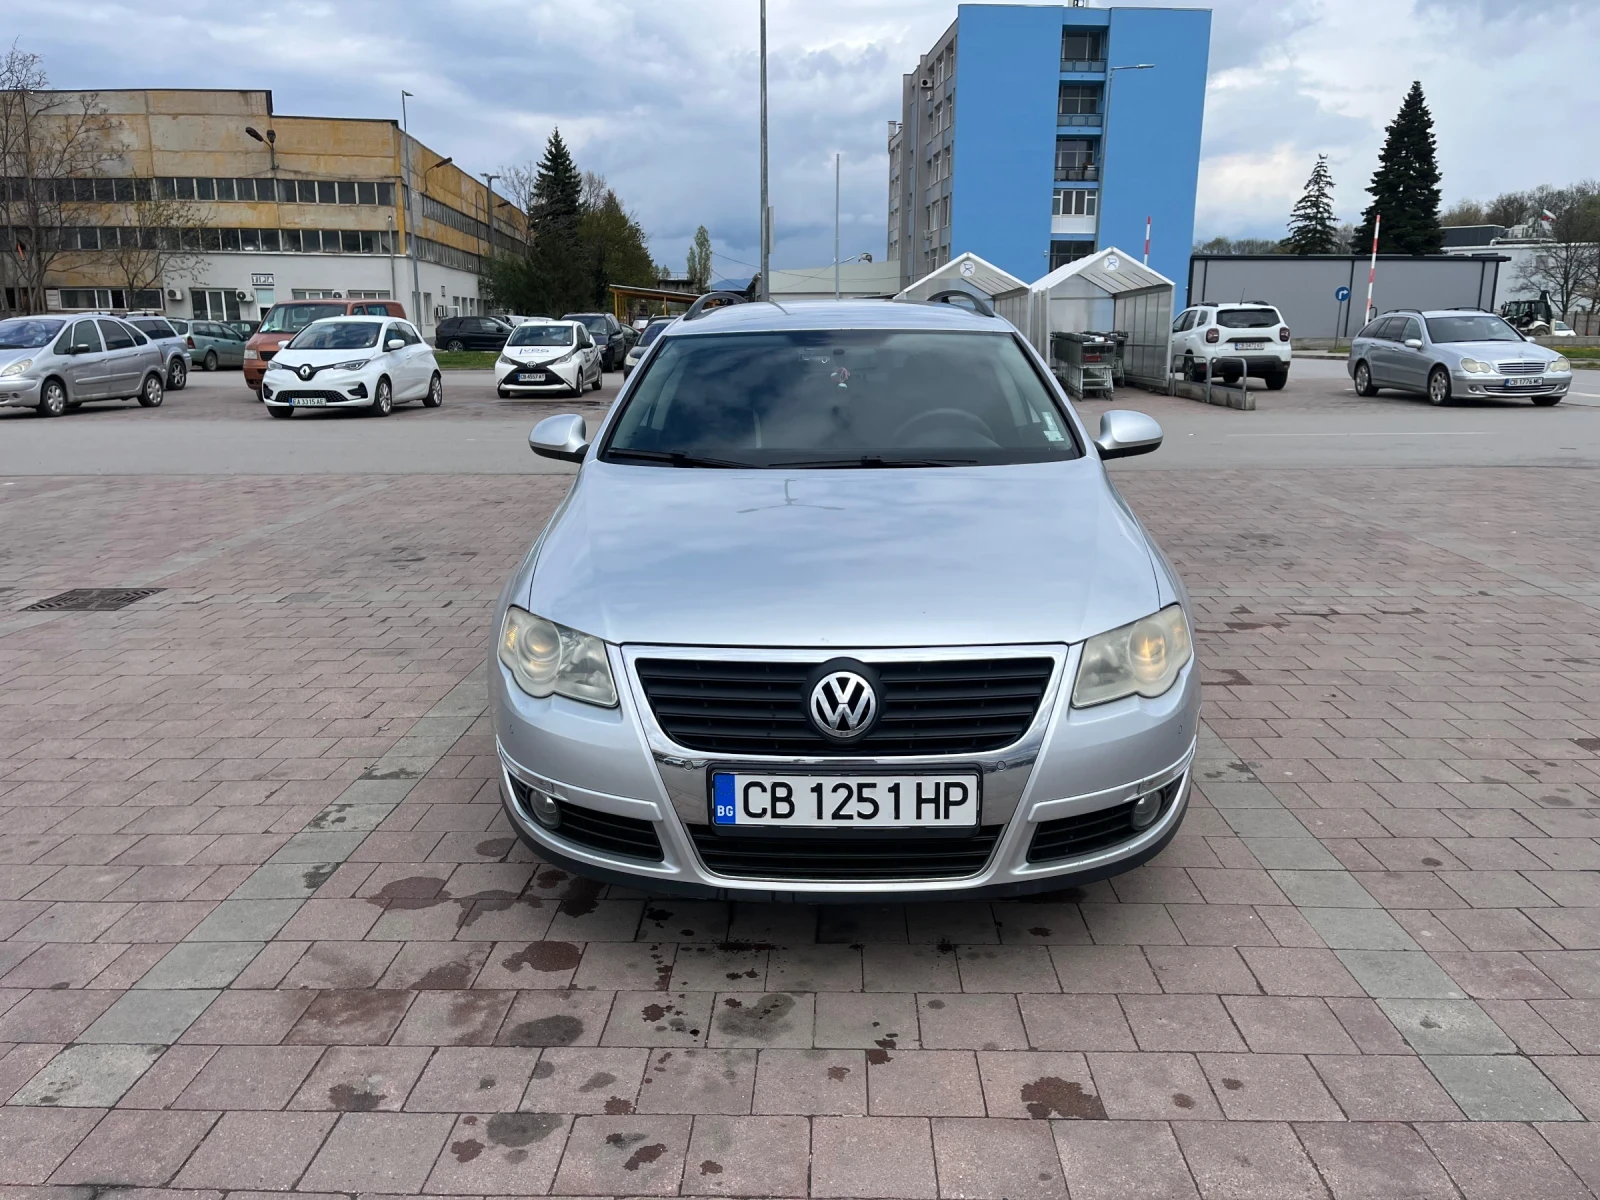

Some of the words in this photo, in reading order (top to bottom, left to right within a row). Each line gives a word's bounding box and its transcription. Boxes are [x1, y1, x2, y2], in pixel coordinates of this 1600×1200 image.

[717, 805, 734, 817] BG
[742, 781, 796, 819] CB
[810, 782, 901, 820] 1251
[915, 781, 969, 820] HP
